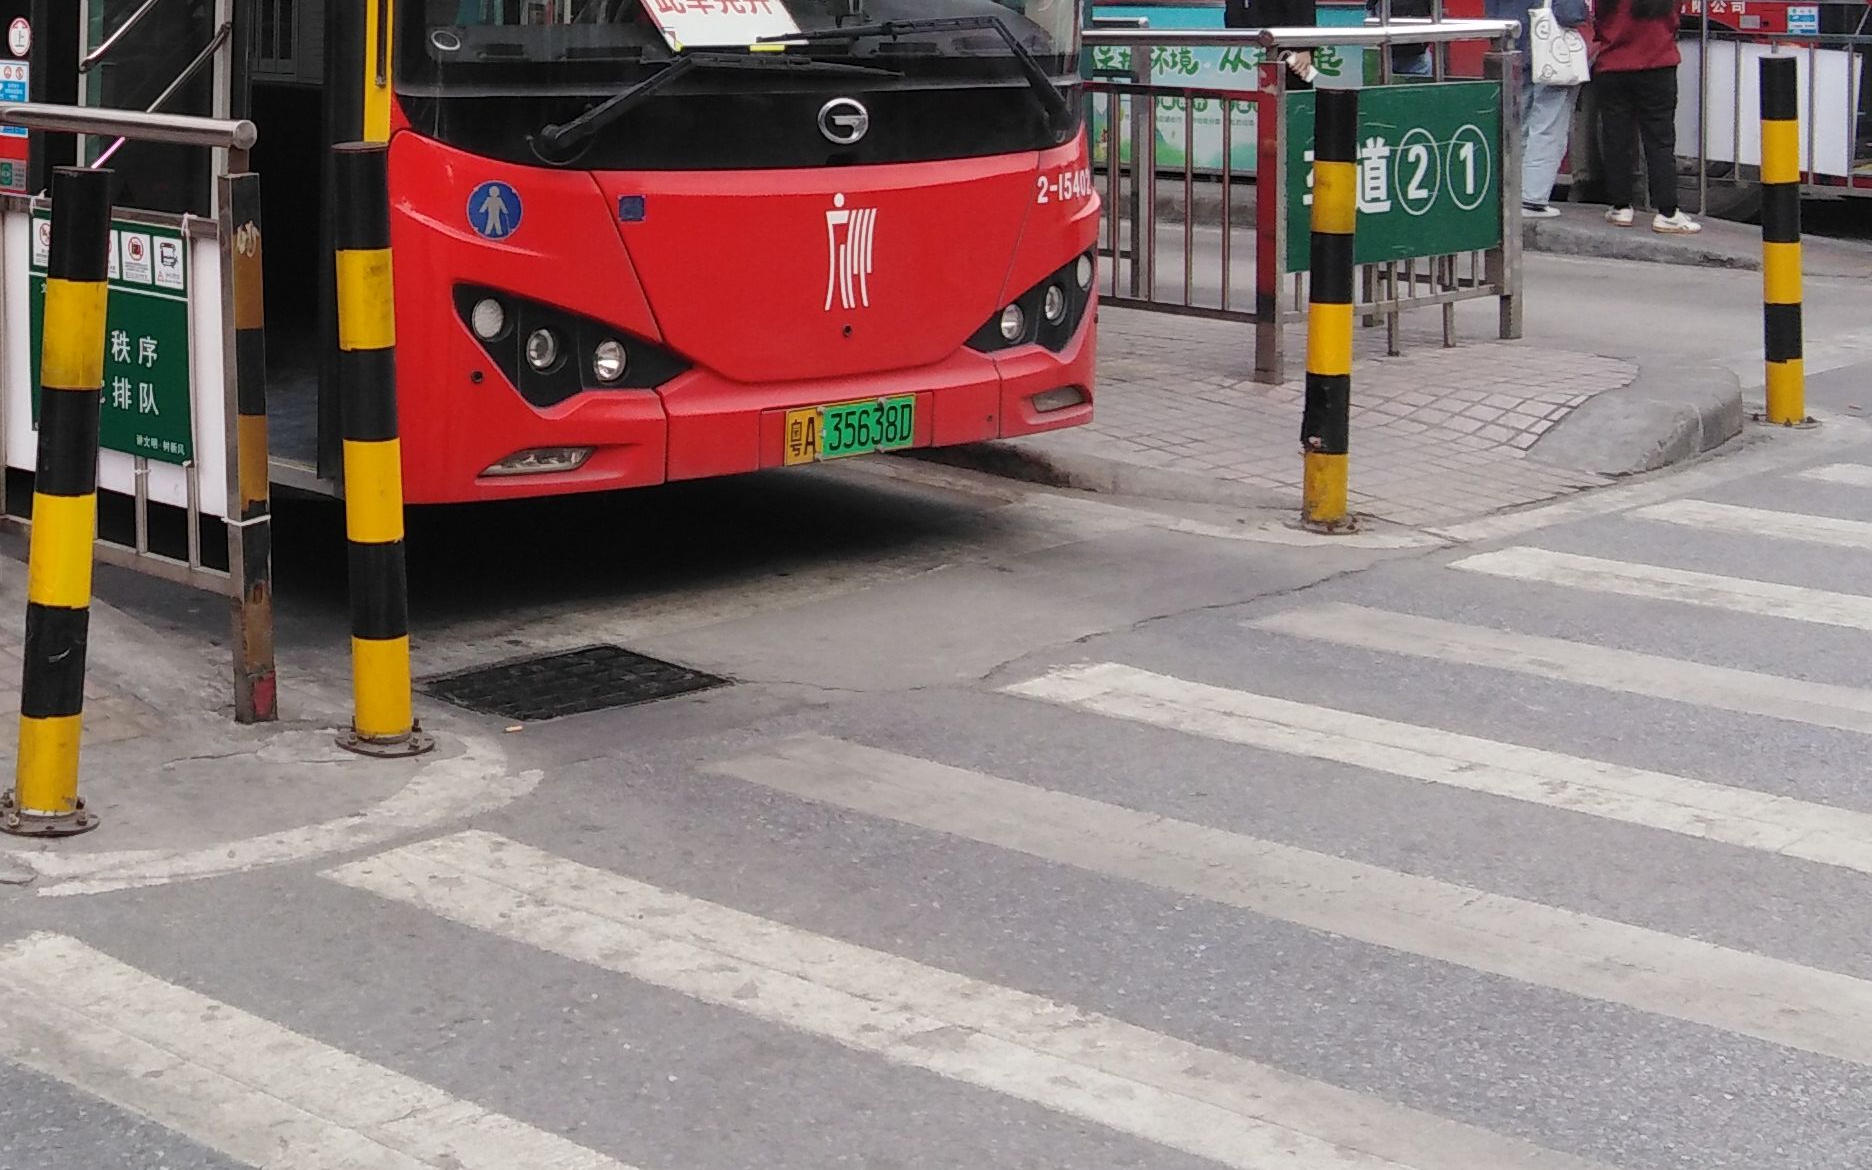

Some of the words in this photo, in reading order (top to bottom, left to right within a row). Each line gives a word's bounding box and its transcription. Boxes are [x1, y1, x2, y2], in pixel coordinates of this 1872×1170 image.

[111, 330, 159, 369] 秩序
[100, 377, 160, 416] 排队
[828, 401, 914, 453] 35638D
